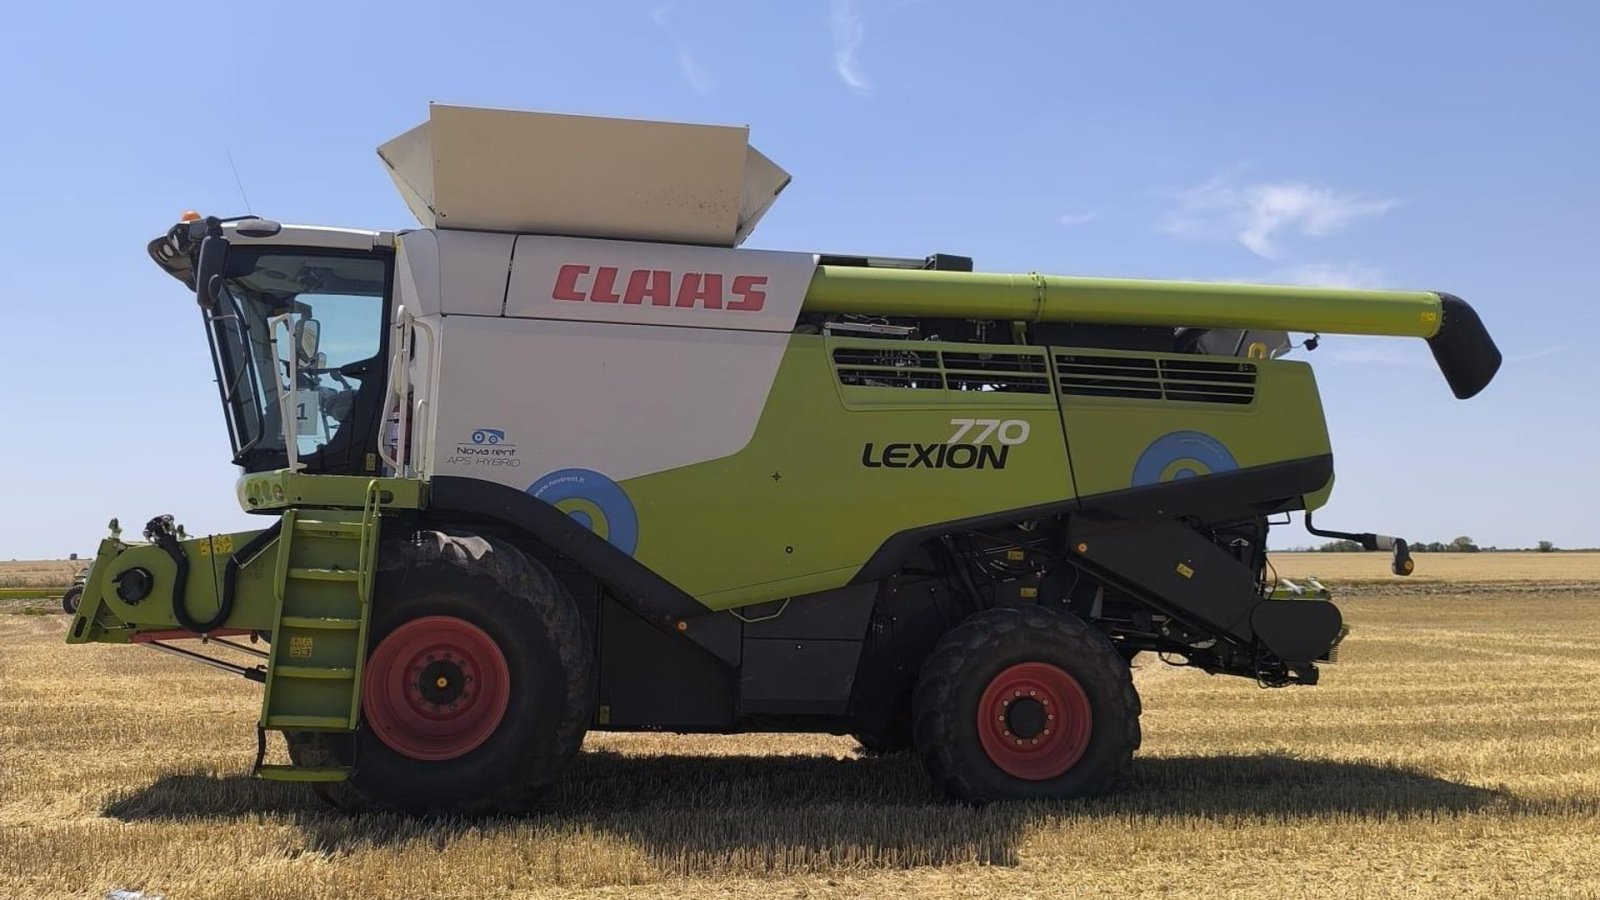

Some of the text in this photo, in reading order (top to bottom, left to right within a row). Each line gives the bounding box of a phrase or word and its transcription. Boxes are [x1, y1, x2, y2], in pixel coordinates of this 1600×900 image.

[552, 264, 768, 311] CLAAS
[296, 402, 309, 420] 1
[947, 418, 1030, 445] 770
[447, 456, 521, 467] APS HYBRID
[456, 446, 516, 457] Nova rent
[861, 442, 1010, 469] LEXION
